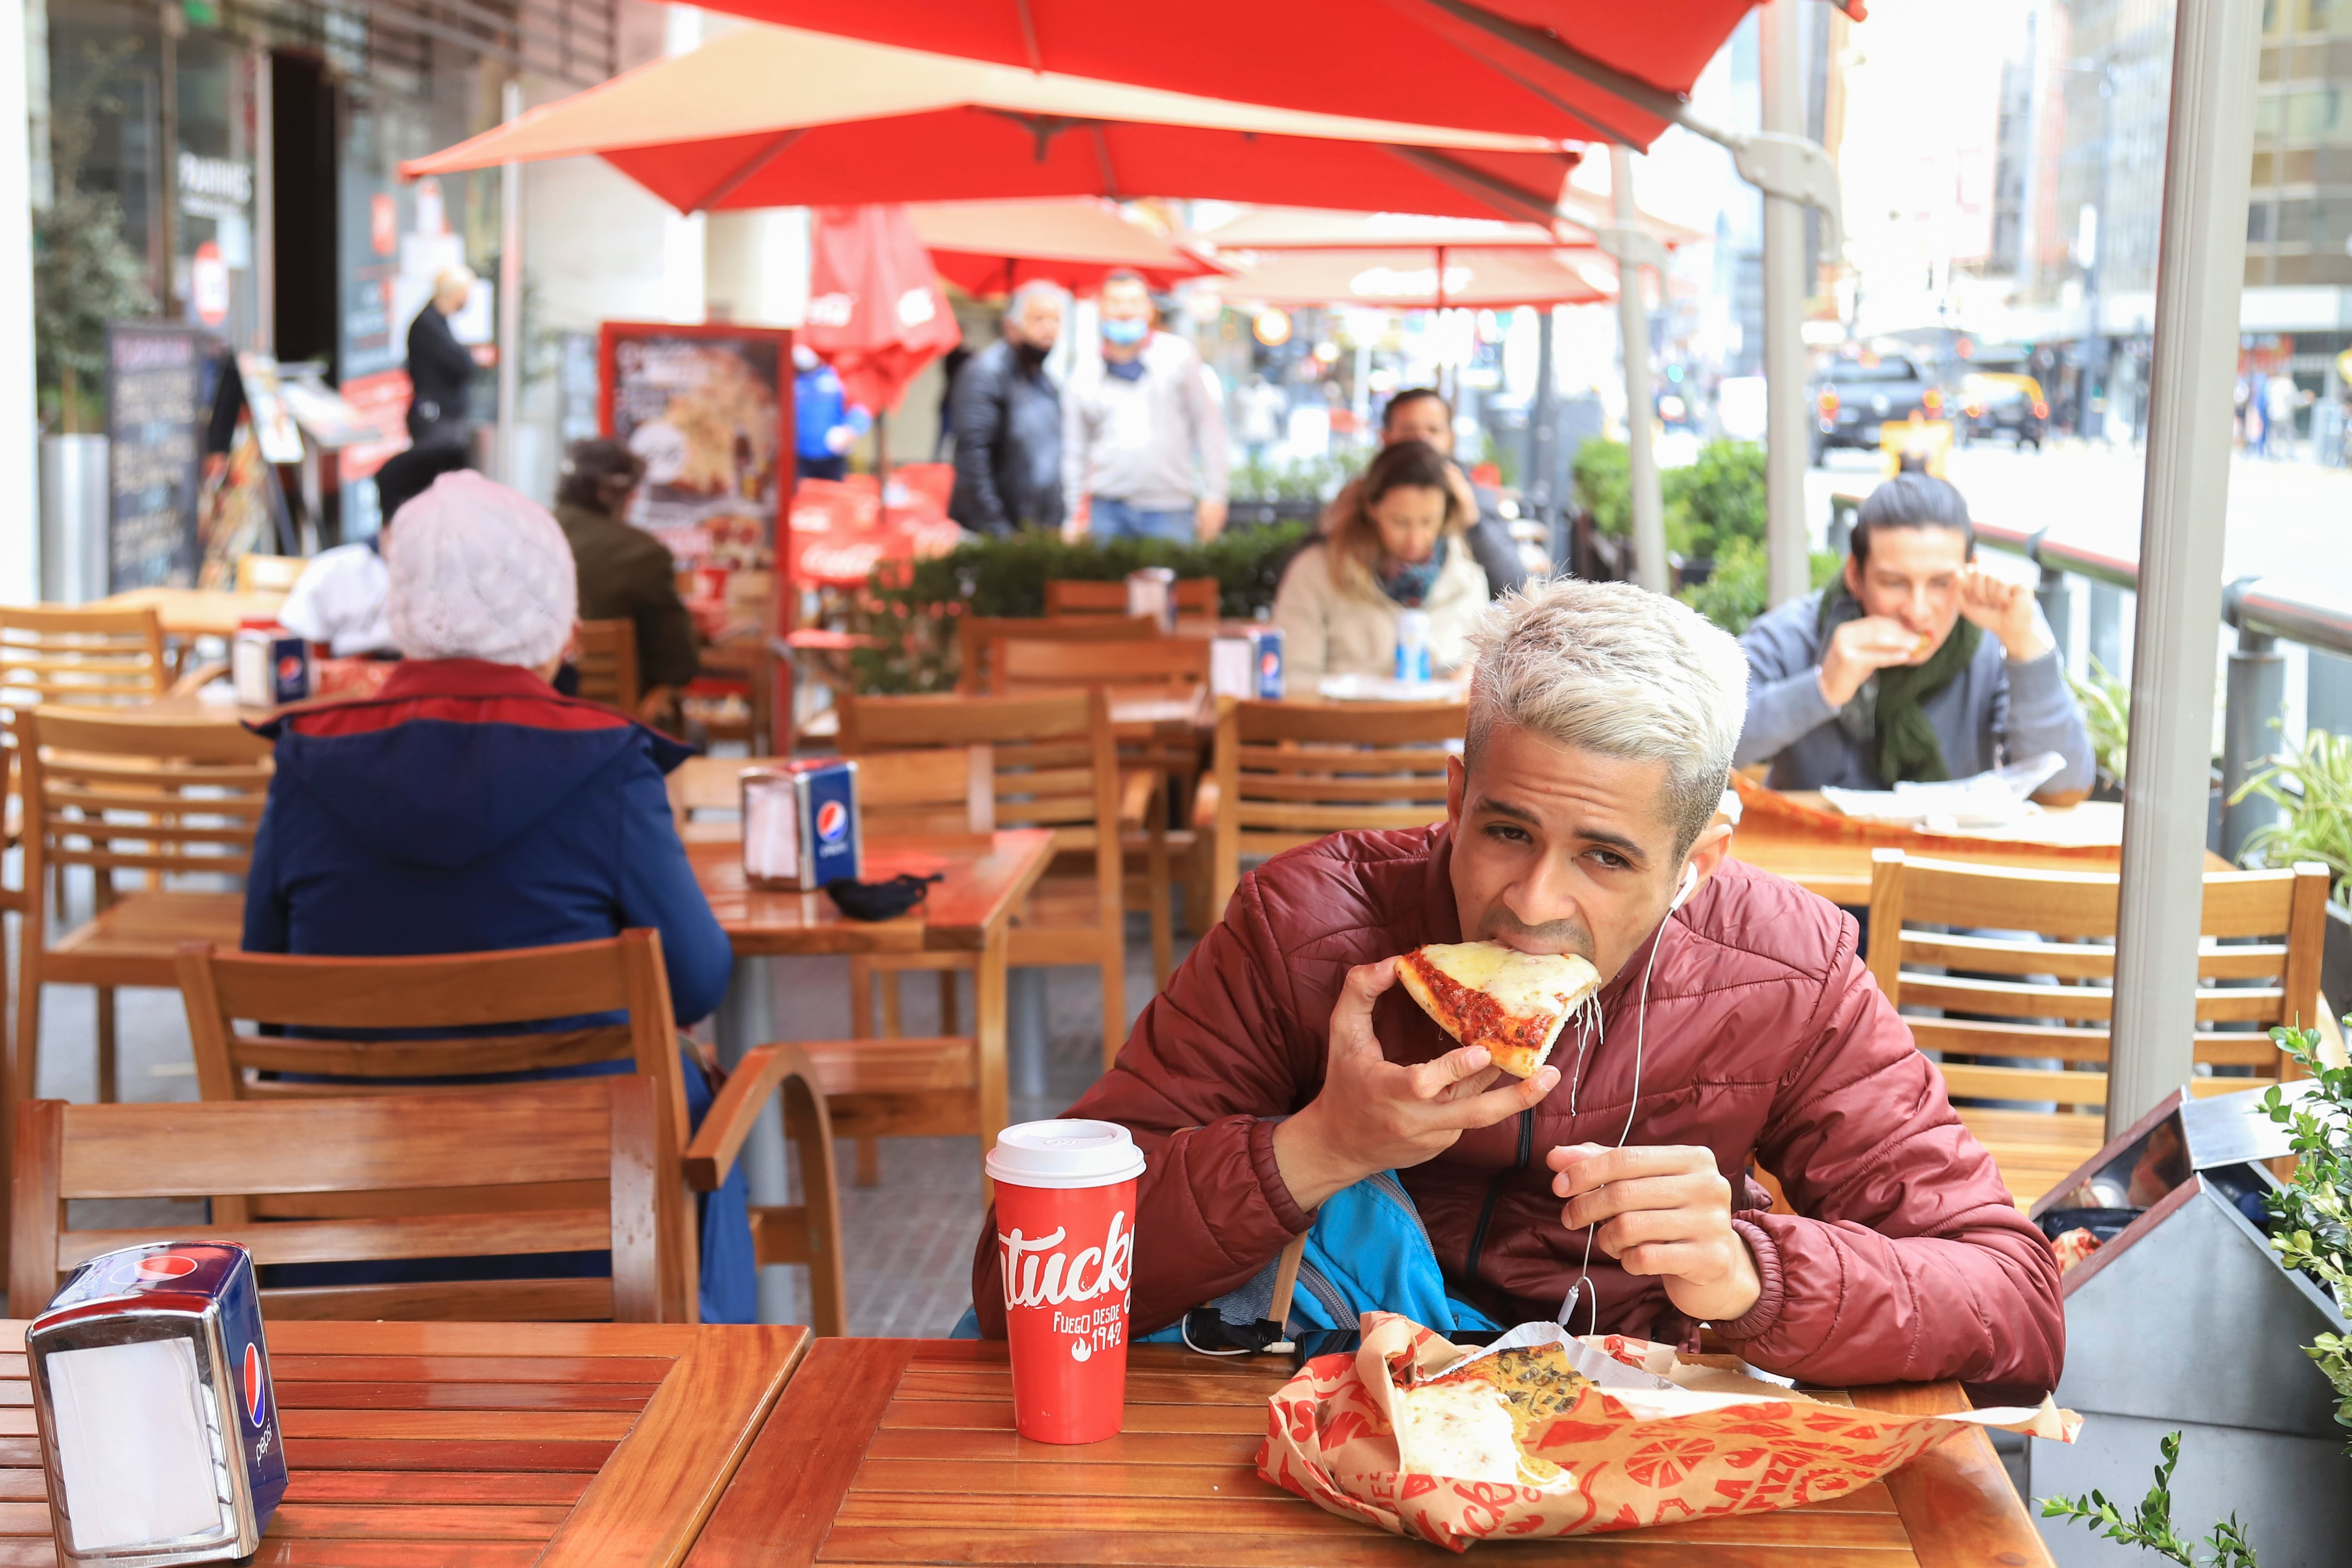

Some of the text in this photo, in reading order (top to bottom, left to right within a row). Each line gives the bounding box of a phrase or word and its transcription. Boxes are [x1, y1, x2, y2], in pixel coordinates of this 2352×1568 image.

[1053, 1304, 1120, 1334] FUEGO DESDE
[1091, 1321, 1122, 1352] 1942
[256, 1418, 272, 1467] pepsi
